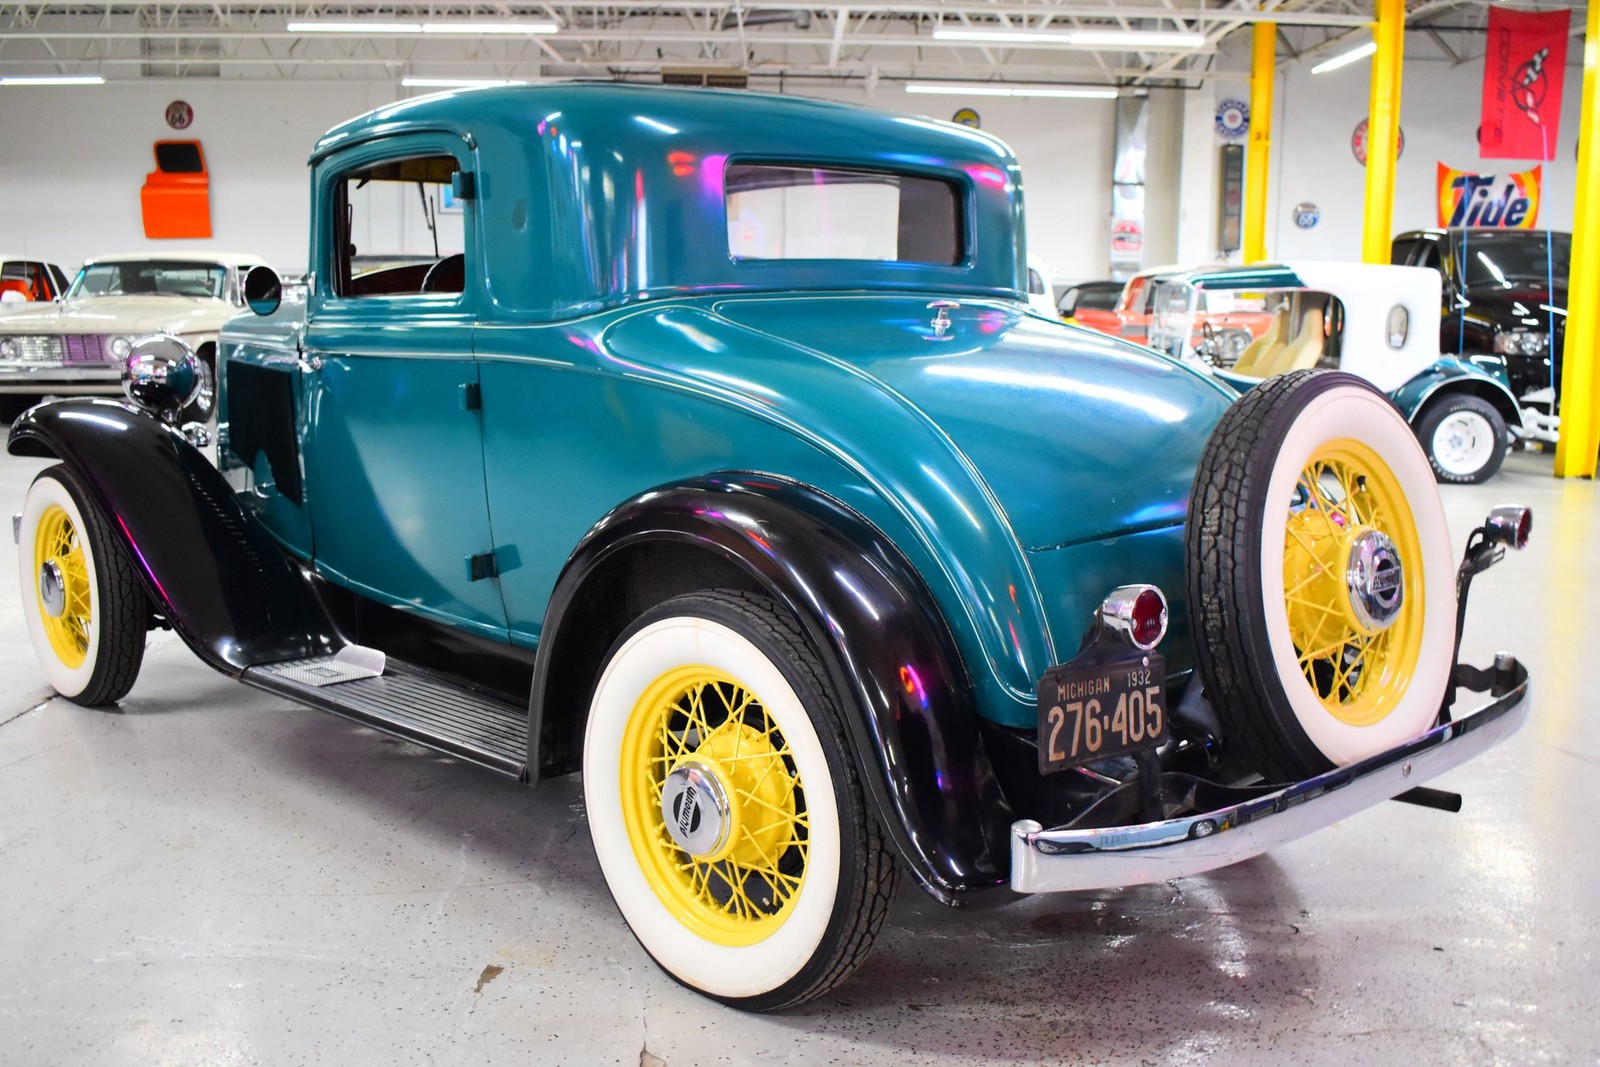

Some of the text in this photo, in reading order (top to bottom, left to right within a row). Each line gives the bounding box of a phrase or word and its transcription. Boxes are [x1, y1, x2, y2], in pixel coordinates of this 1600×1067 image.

[1448, 174, 1530, 227] Tide
[1057, 670, 1151, 702] MICHIGAN 1932
